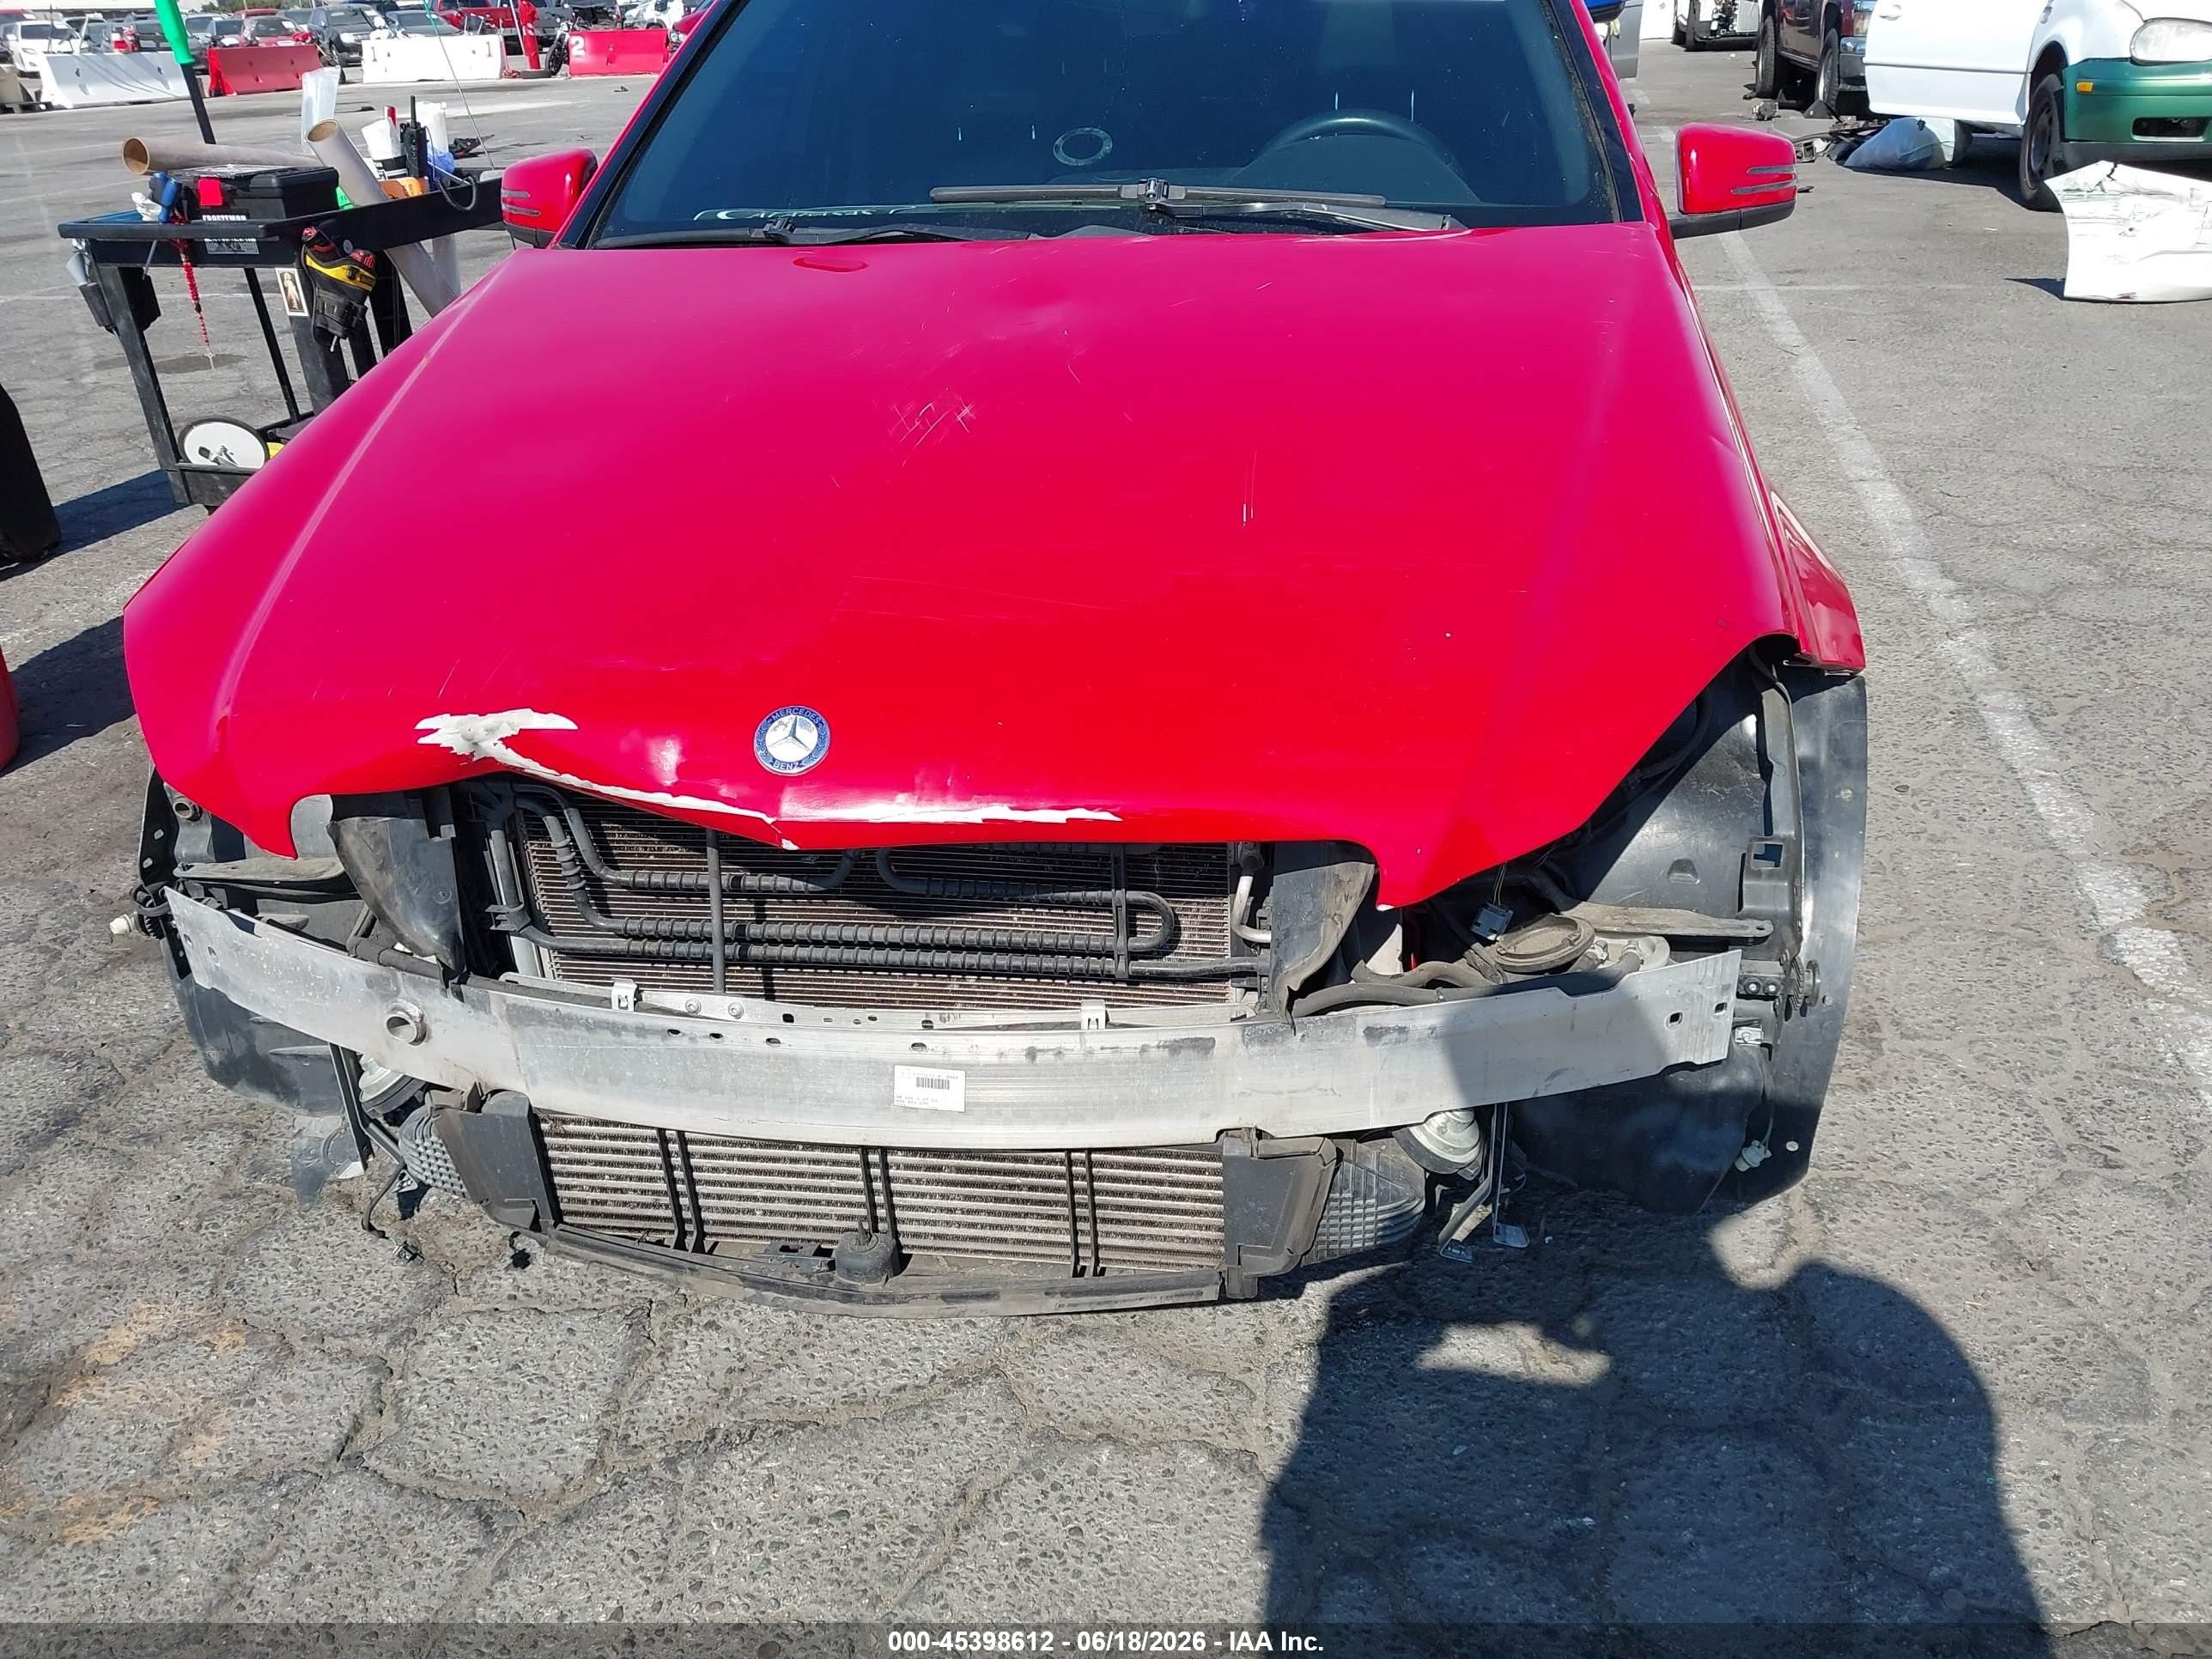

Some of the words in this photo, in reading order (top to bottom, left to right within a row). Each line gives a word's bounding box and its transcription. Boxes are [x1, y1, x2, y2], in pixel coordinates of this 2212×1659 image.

[485, 41, 492, 58] 1
[570, 35, 586, 56] 2
[370, 46, 378, 62] 1
[772, 708, 822, 724] MERCEDES
[773, 762, 802, 770] BENZ
